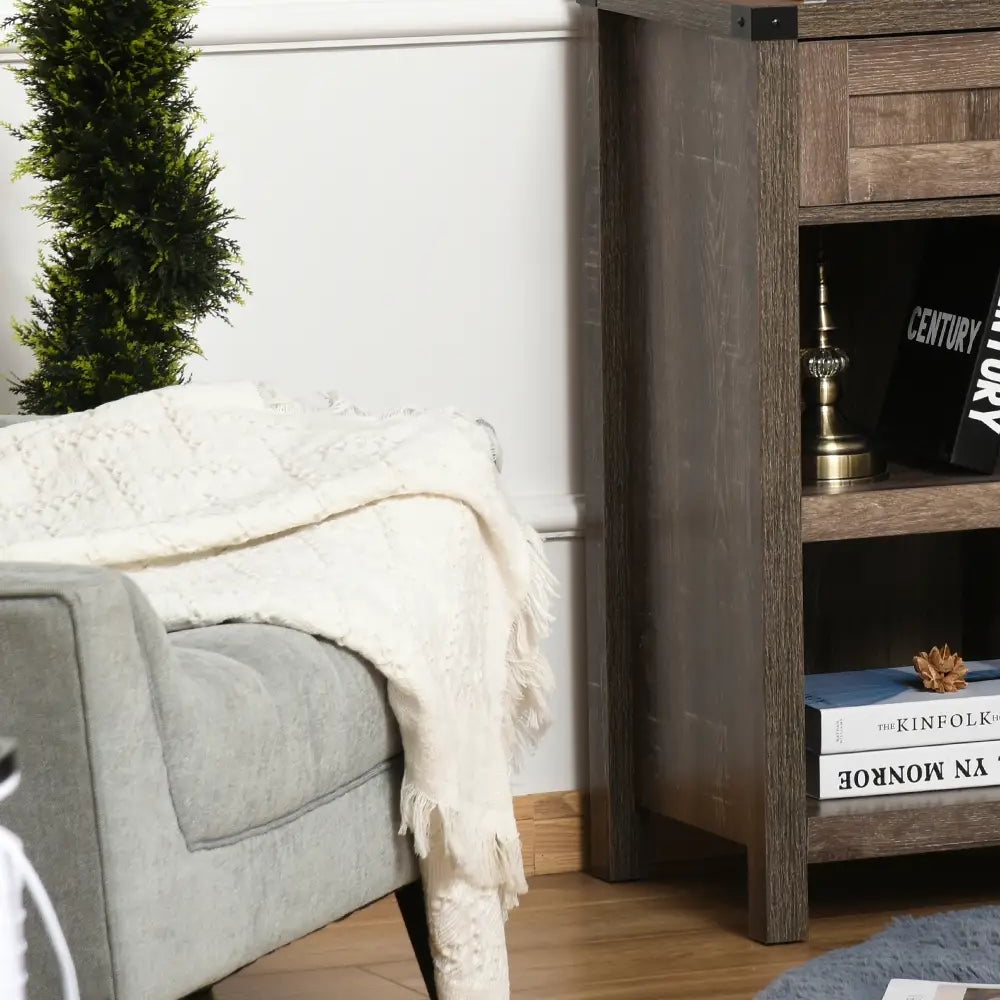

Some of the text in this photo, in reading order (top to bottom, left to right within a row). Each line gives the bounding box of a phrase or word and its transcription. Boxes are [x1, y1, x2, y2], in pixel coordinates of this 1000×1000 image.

[907, 305, 982, 355] CENTURY
[877, 722, 896, 732] THE
[896, 710, 992, 733] KINFOLK
[838, 761, 945, 790] MONROE
